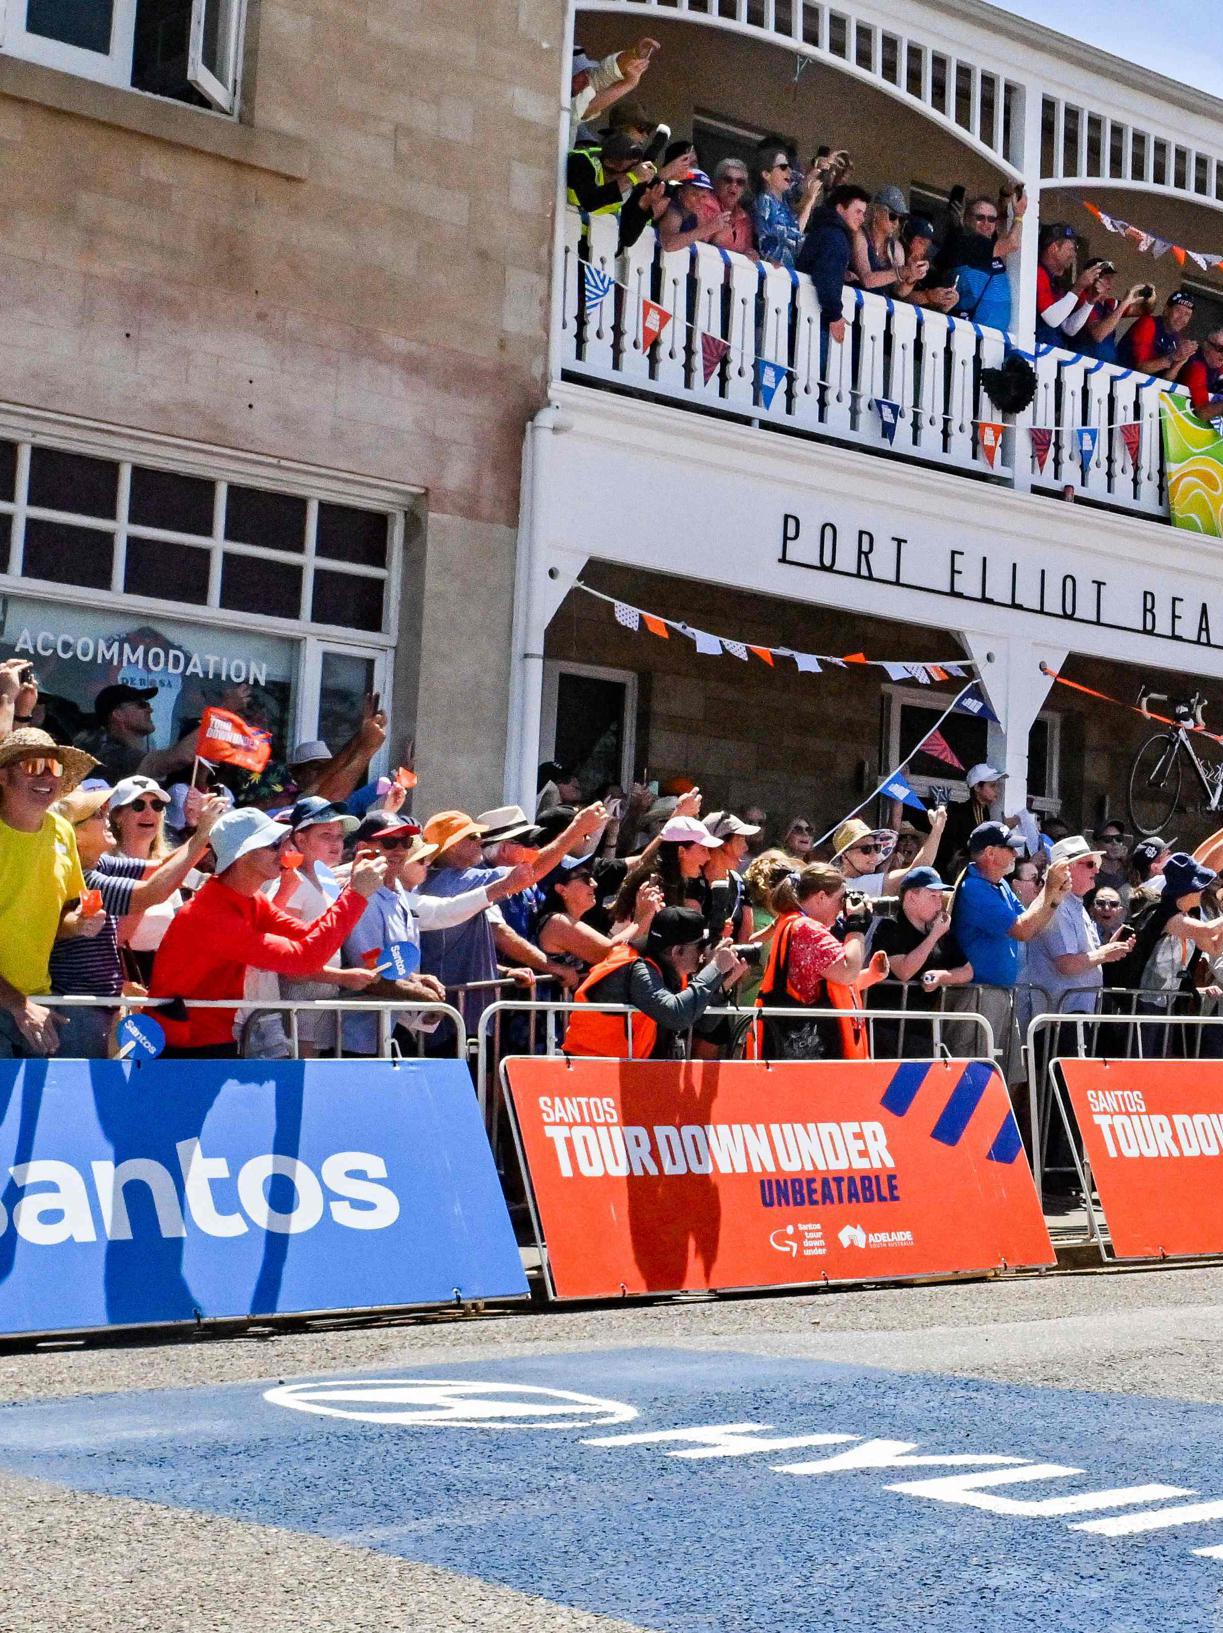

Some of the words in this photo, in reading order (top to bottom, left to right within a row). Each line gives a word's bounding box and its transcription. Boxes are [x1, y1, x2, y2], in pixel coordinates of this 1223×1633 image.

[782, 513, 907, 584] PORT
[950, 549, 1106, 626] ELLIOT
[14, 629, 267, 687] ACCOMMODATION
[123, 1017, 158, 1056] Santos
[539, 1096, 619, 1124] SANTOS
[1086, 1090, 1146, 1113] SANTOS
[544, 1125, 658, 1177] TOUR
[652, 1123, 776, 1176] DOWN
[774, 1121, 896, 1173] UNDER
[1094, 1114, 1180, 1158] TOUR
[0, 1136, 401, 1246] antos
[760, 1173, 900, 1208] UNBEATABLE
[803, 1239, 826, 1247] down
[803, 1247, 827, 1256] under
[804, 1231, 823, 1239] tour
[868, 1231, 913, 1243] ADELAIDE
